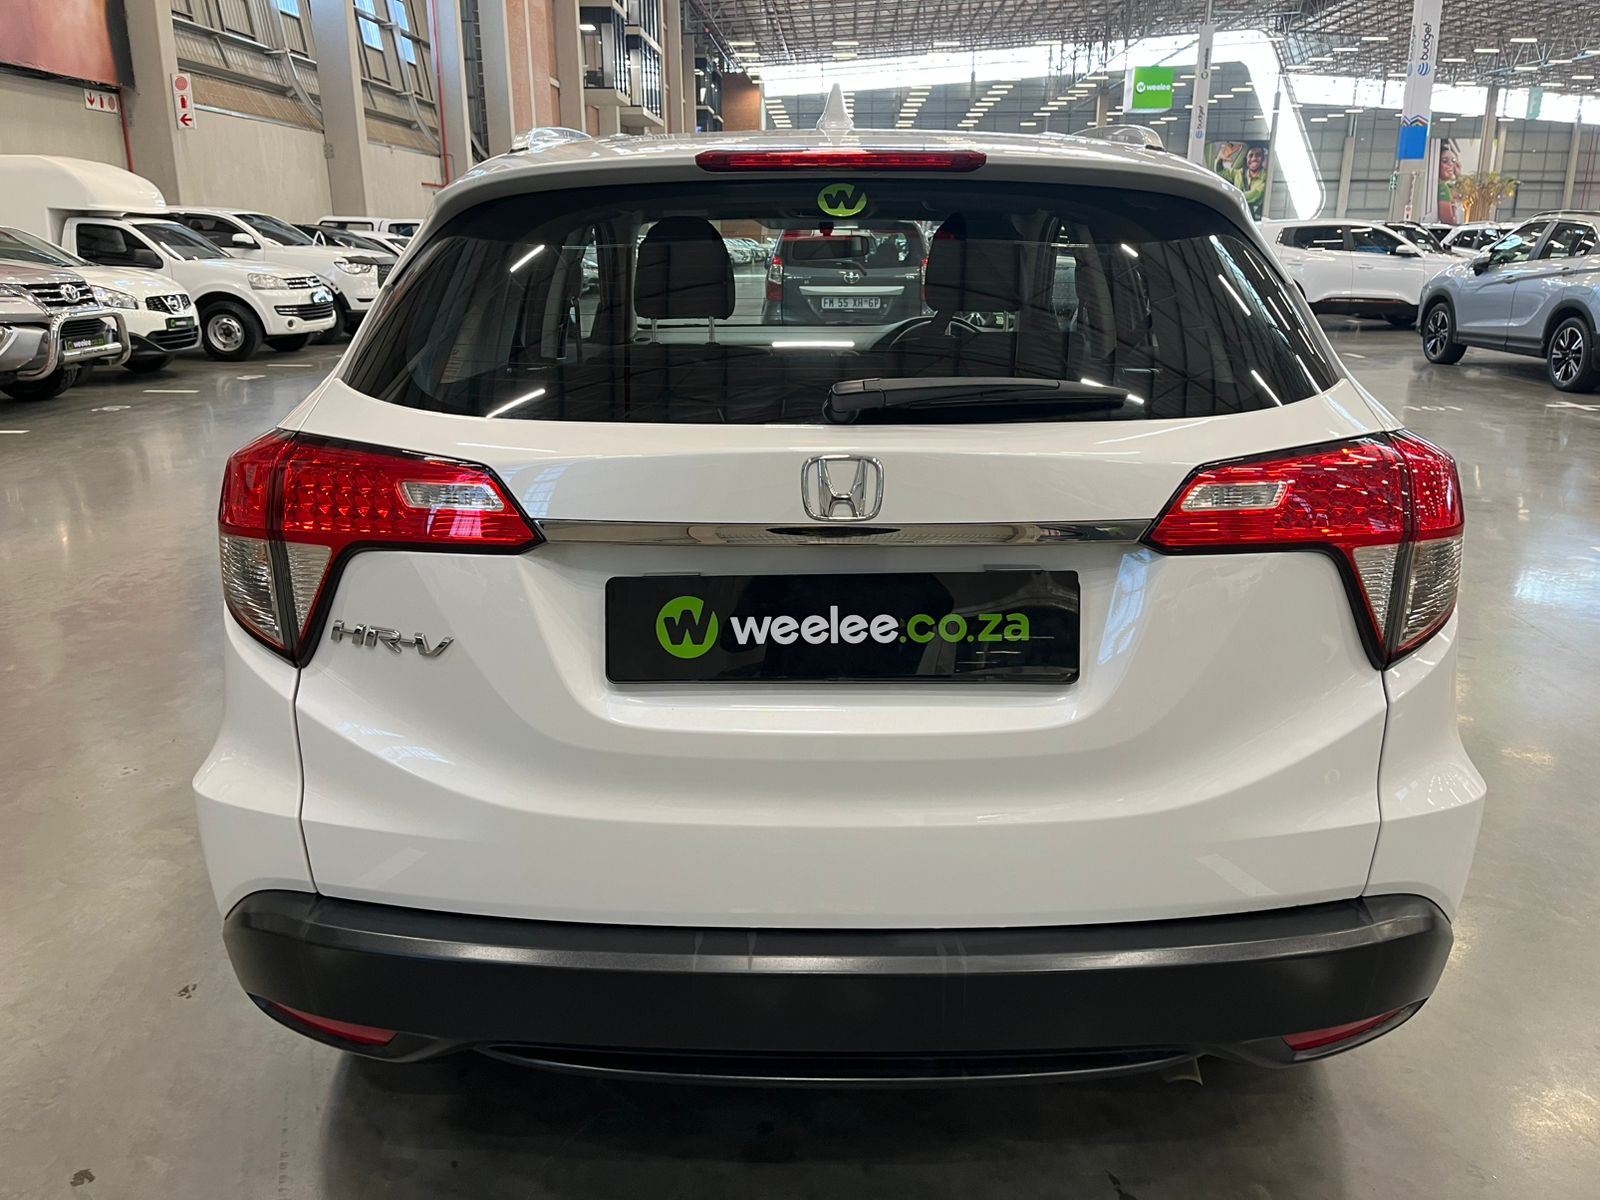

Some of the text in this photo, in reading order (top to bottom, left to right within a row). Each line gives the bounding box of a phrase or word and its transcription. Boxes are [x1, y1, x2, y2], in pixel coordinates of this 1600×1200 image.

[1420, 22, 1434, 61] budget
[838, 298, 848, 307] 55
[853, 298, 862, 307] XH
[869, 298, 879, 307] GP
[331, 619, 455, 658] HR-V
[730, 605, 1030, 645] weelee.co.za
